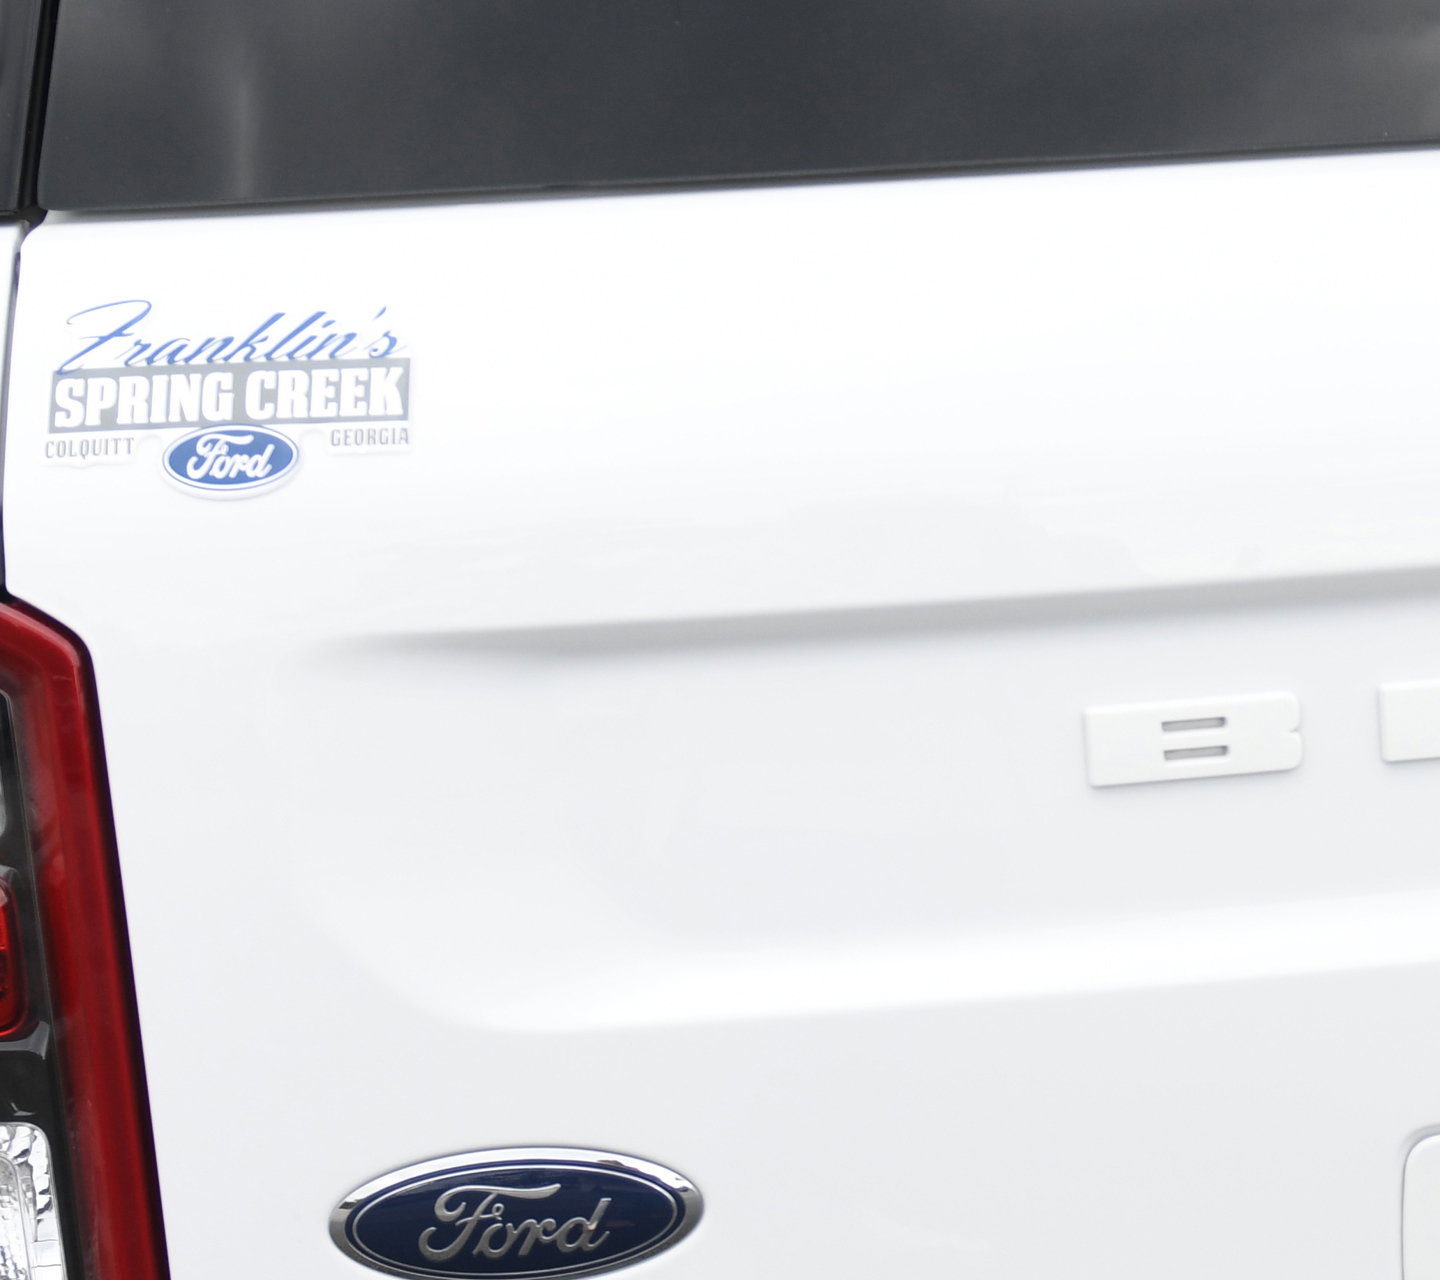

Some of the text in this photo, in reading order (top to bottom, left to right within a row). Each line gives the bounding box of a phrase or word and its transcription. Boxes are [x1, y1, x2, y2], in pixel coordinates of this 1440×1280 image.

[56, 299, 402, 375] Franklin's
[54, 366, 404, 428] SPRING CREEK
[45, 426, 410, 460] COLQUITT GEORGIA
[186, 433, 275, 480] Ford
[418, 1183, 612, 1262] Ford
